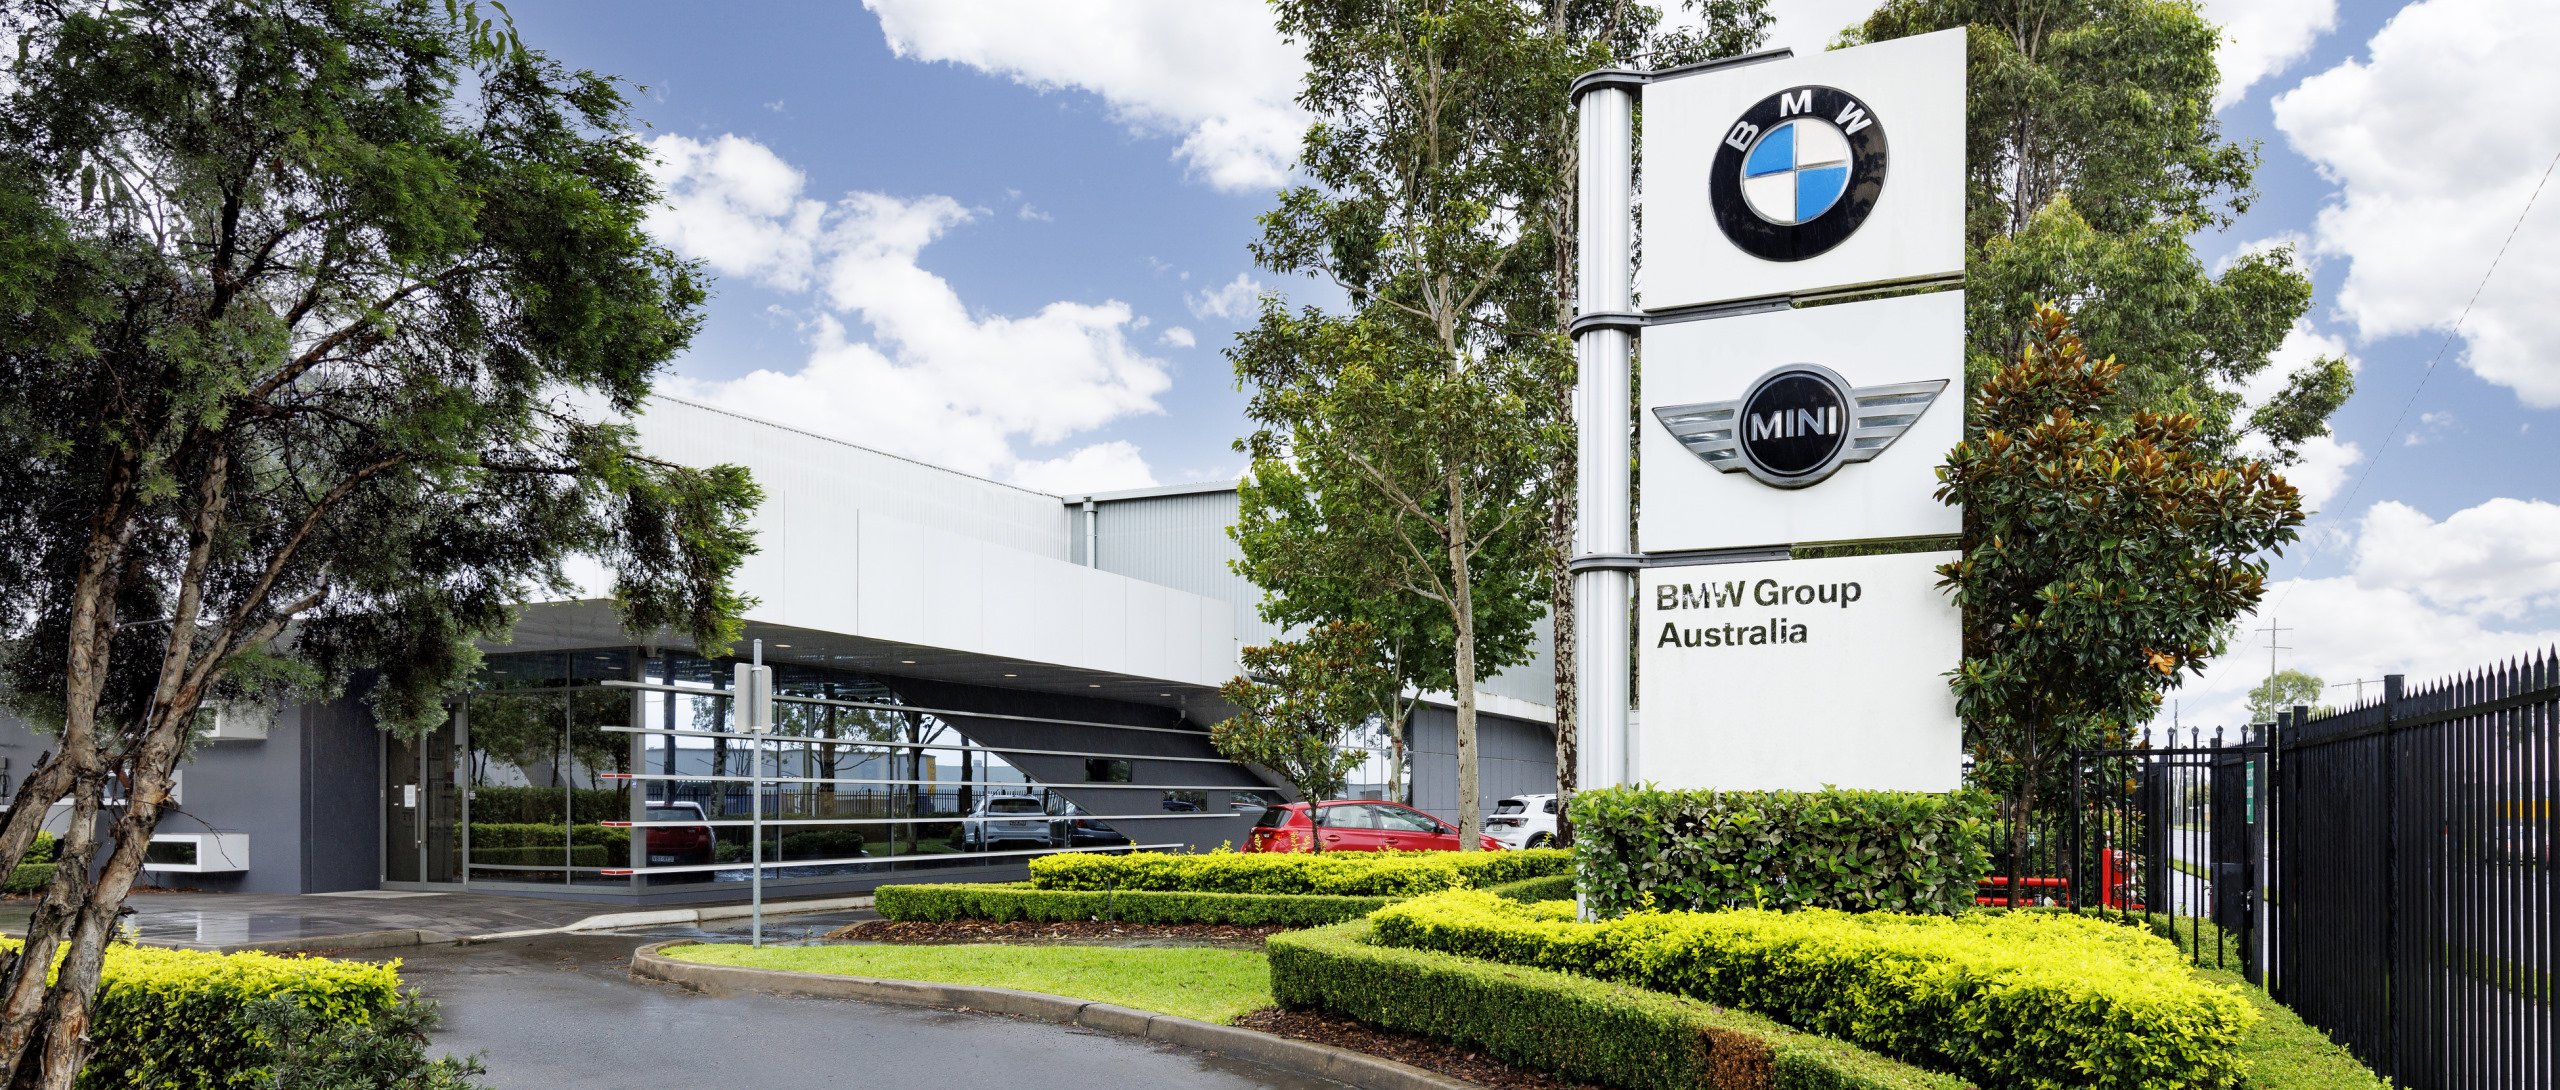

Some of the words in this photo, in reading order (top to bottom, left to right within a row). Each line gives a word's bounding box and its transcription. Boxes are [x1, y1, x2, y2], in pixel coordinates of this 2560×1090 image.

[1725, 89, 1873, 153] BMW
[1750, 406, 1838, 442] MINI
[1656, 580, 1746, 611] BMW
[1753, 578, 1862, 609] Group
[1656, 617, 1808, 649] Australia
